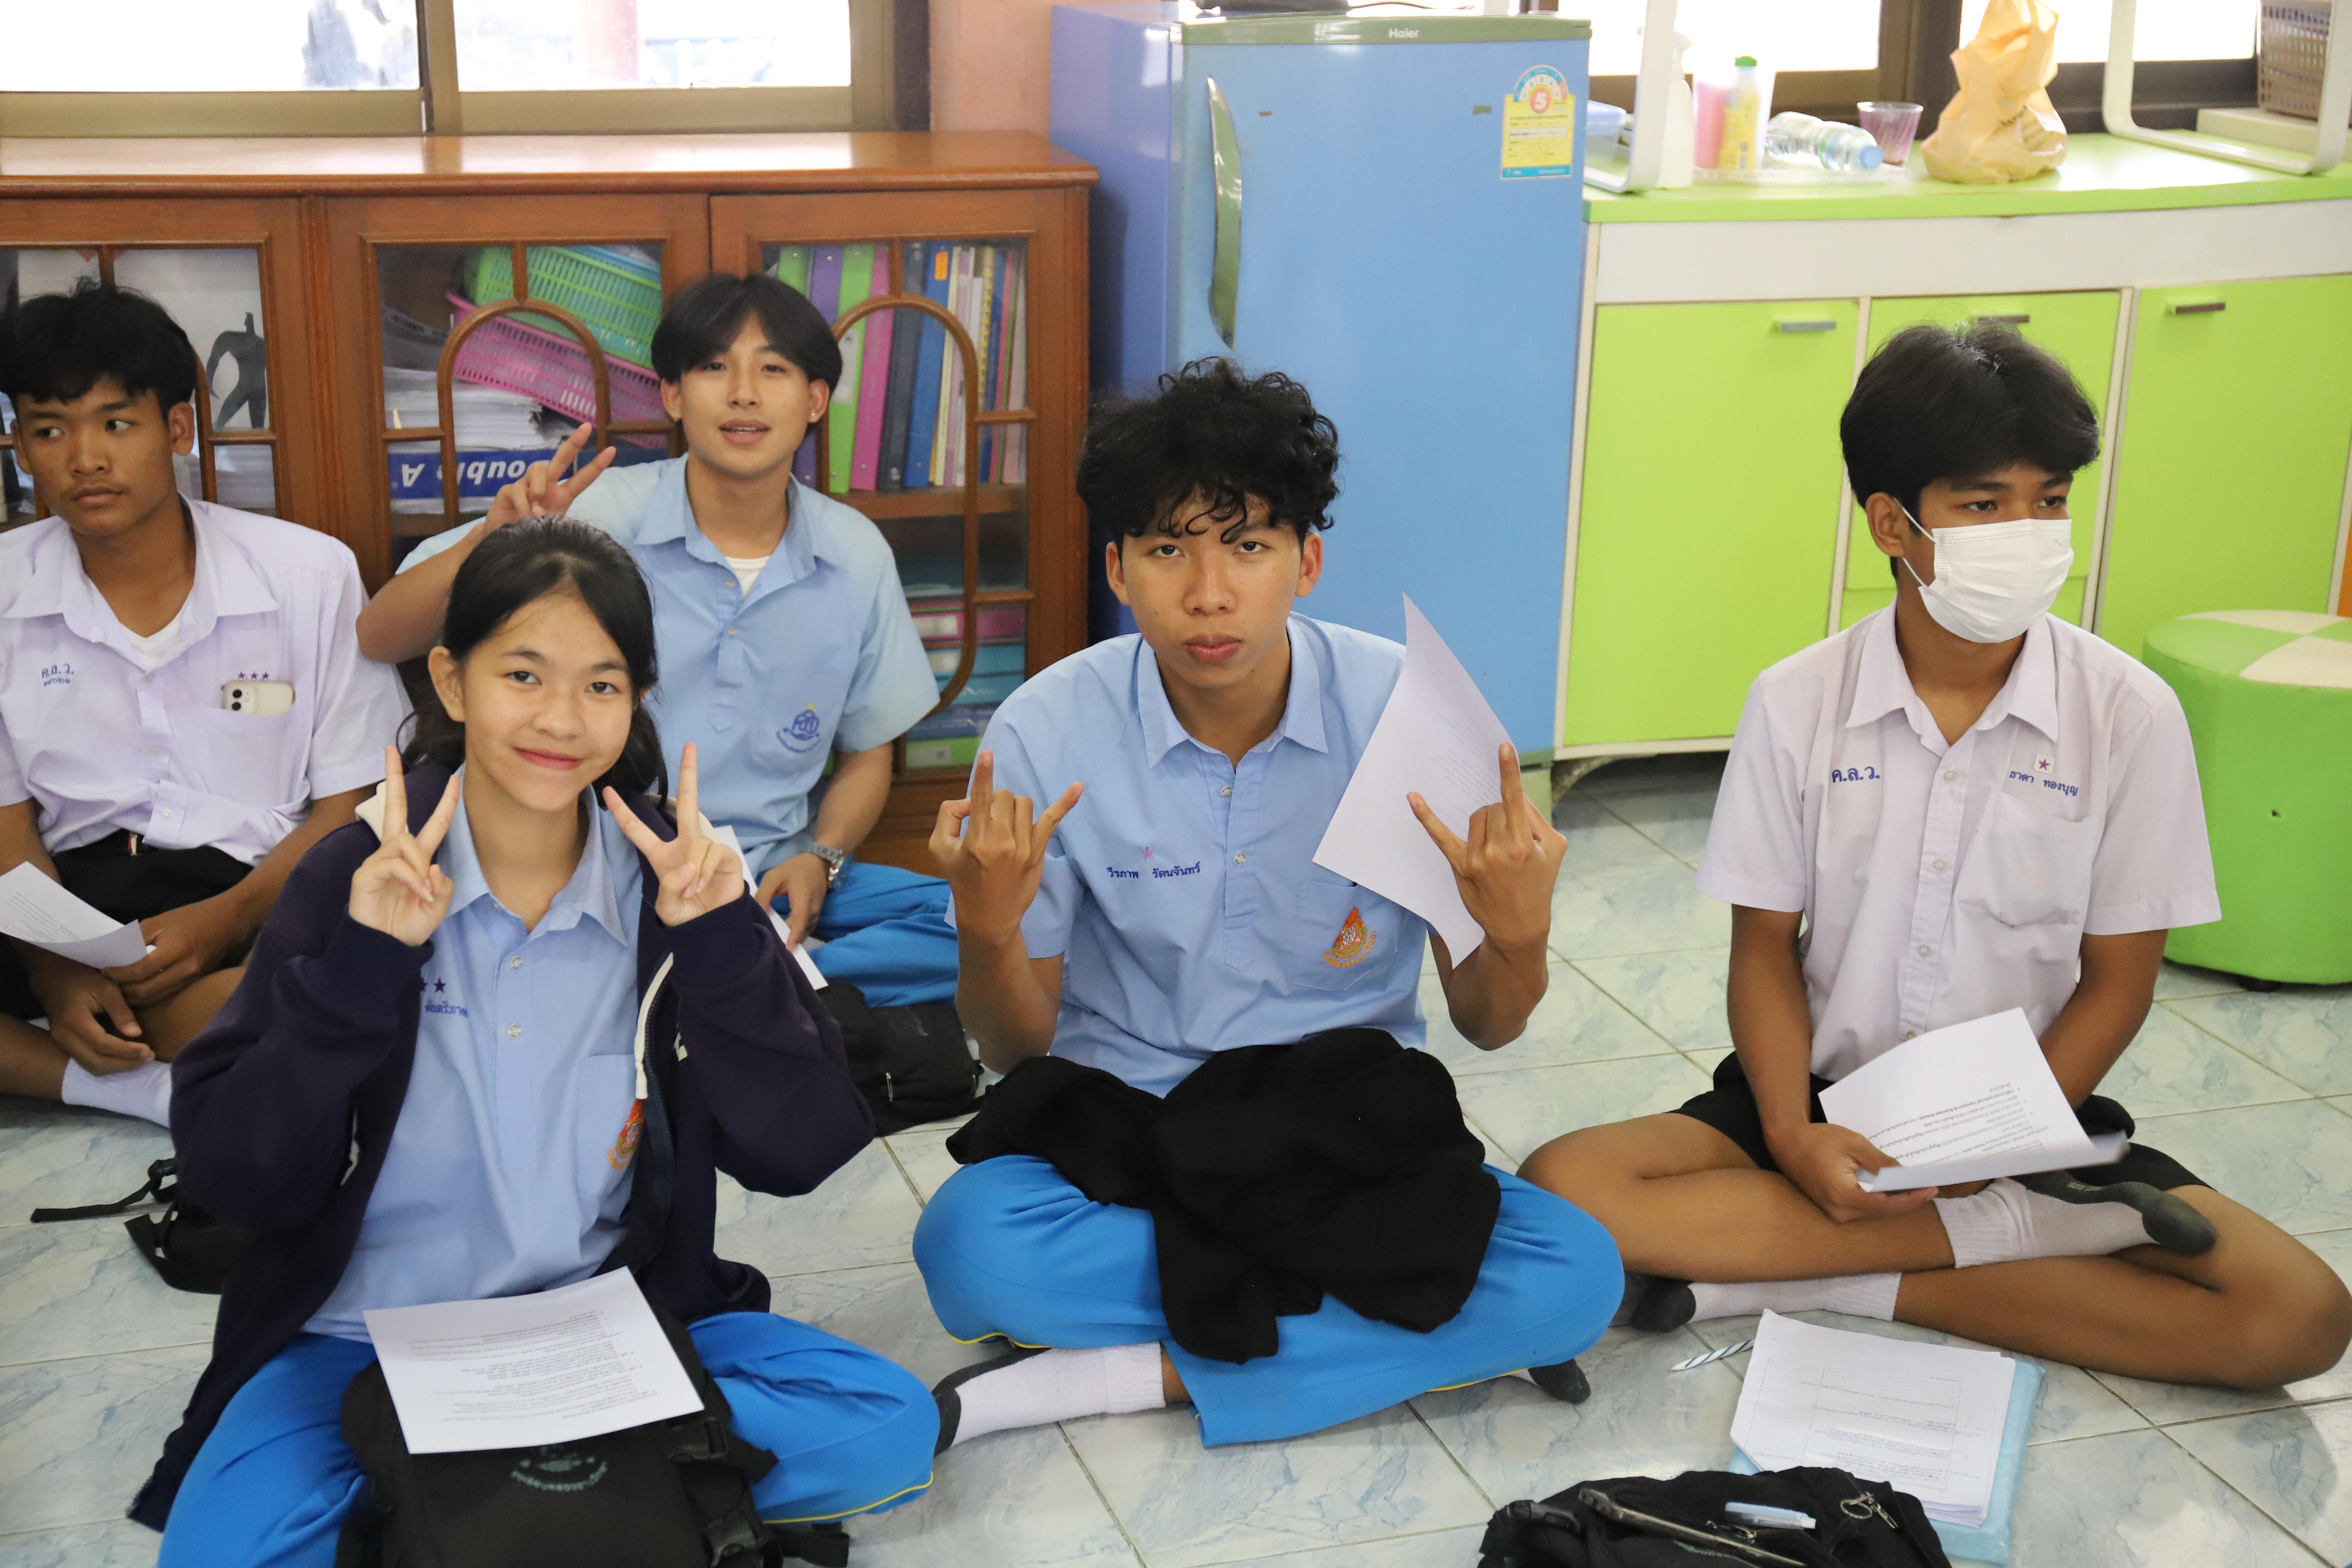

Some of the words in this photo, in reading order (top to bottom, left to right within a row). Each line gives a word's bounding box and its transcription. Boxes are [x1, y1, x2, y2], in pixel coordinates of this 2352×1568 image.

[1388, 28, 1419, 38] Haier
[1535, 92, 1547, 110] 5
[401, 463, 425, 487] A
[1832, 766, 1880, 782] ค.ล.ว.
[2043, 779, 2078, 796] ทองบุญ
[1152, 861, 1200, 879] รัตนจันทร์
